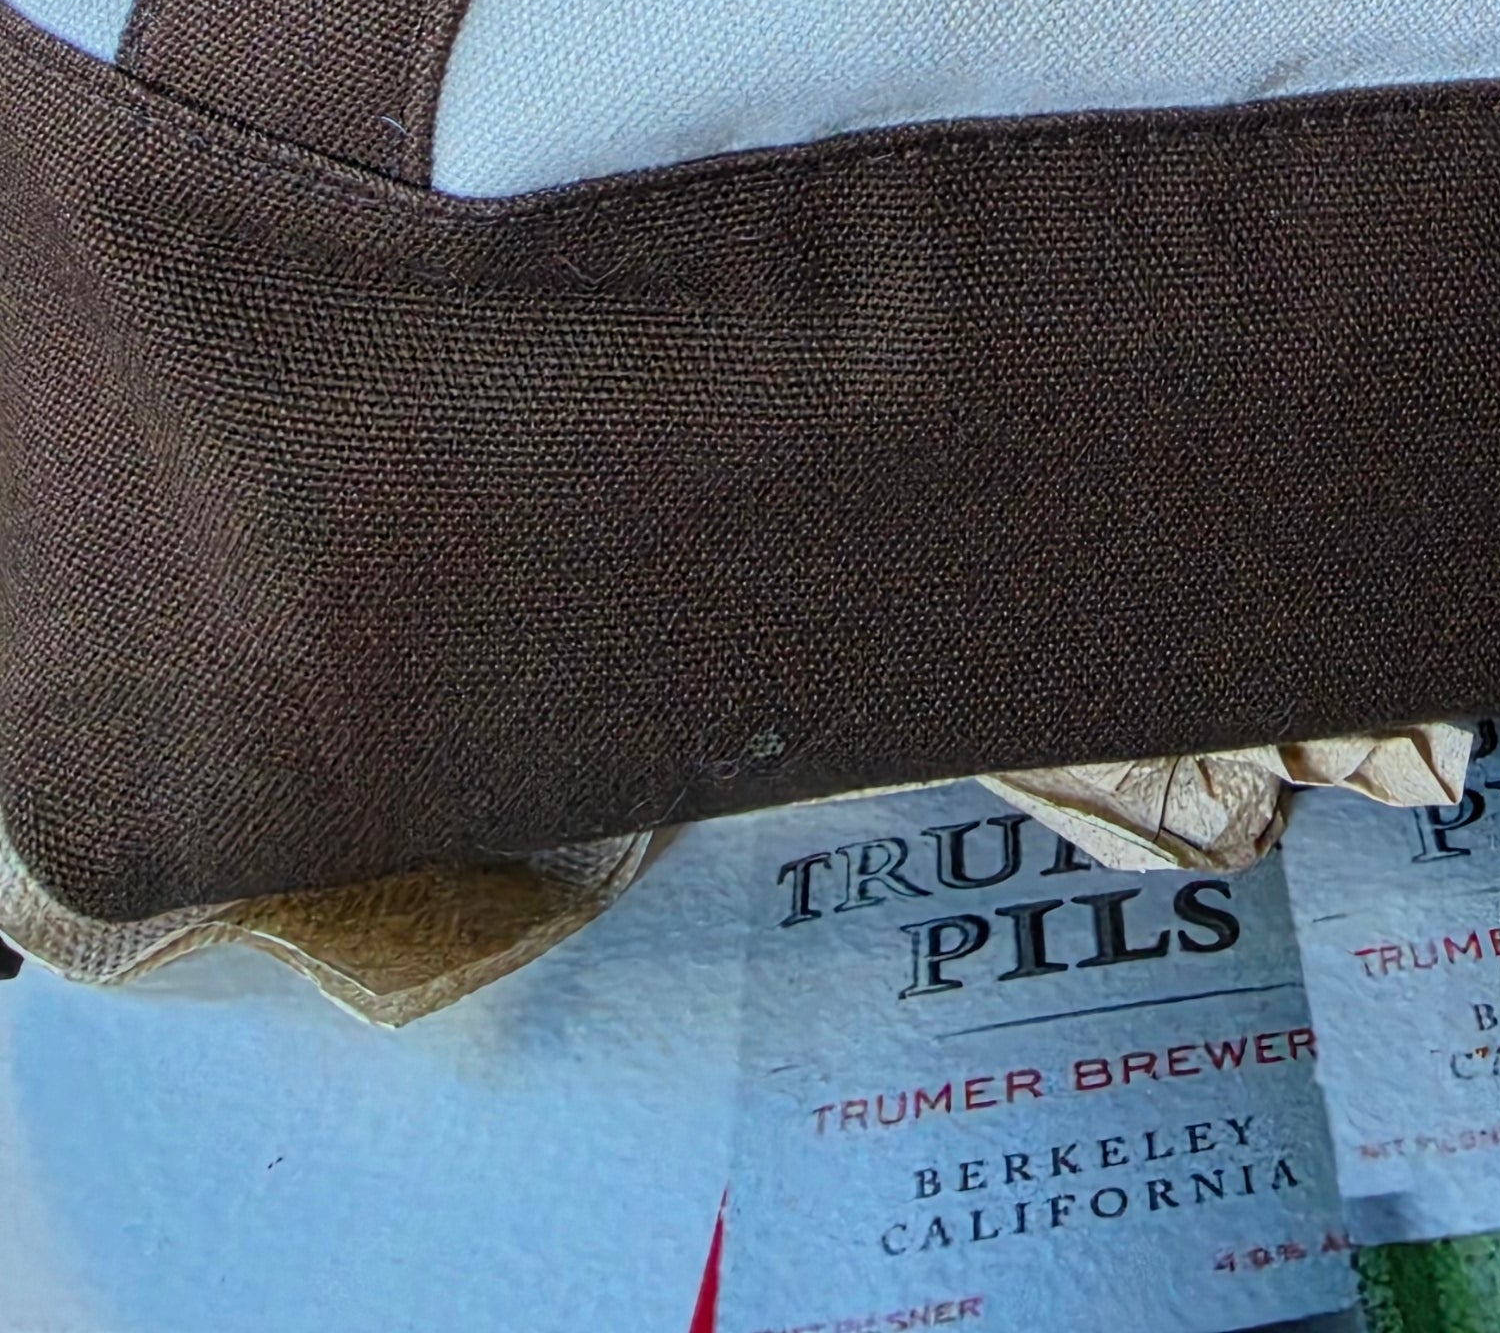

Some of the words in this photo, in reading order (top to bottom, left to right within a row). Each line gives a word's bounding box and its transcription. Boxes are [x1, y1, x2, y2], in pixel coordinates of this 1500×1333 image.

[898, 879, 1242, 1001] PILS
[811, 1067, 1044, 1136] TRUMER
[913, 1115, 1257, 1201] BERKELEY
[880, 1158, 1300, 1259] CALIFORNIA
